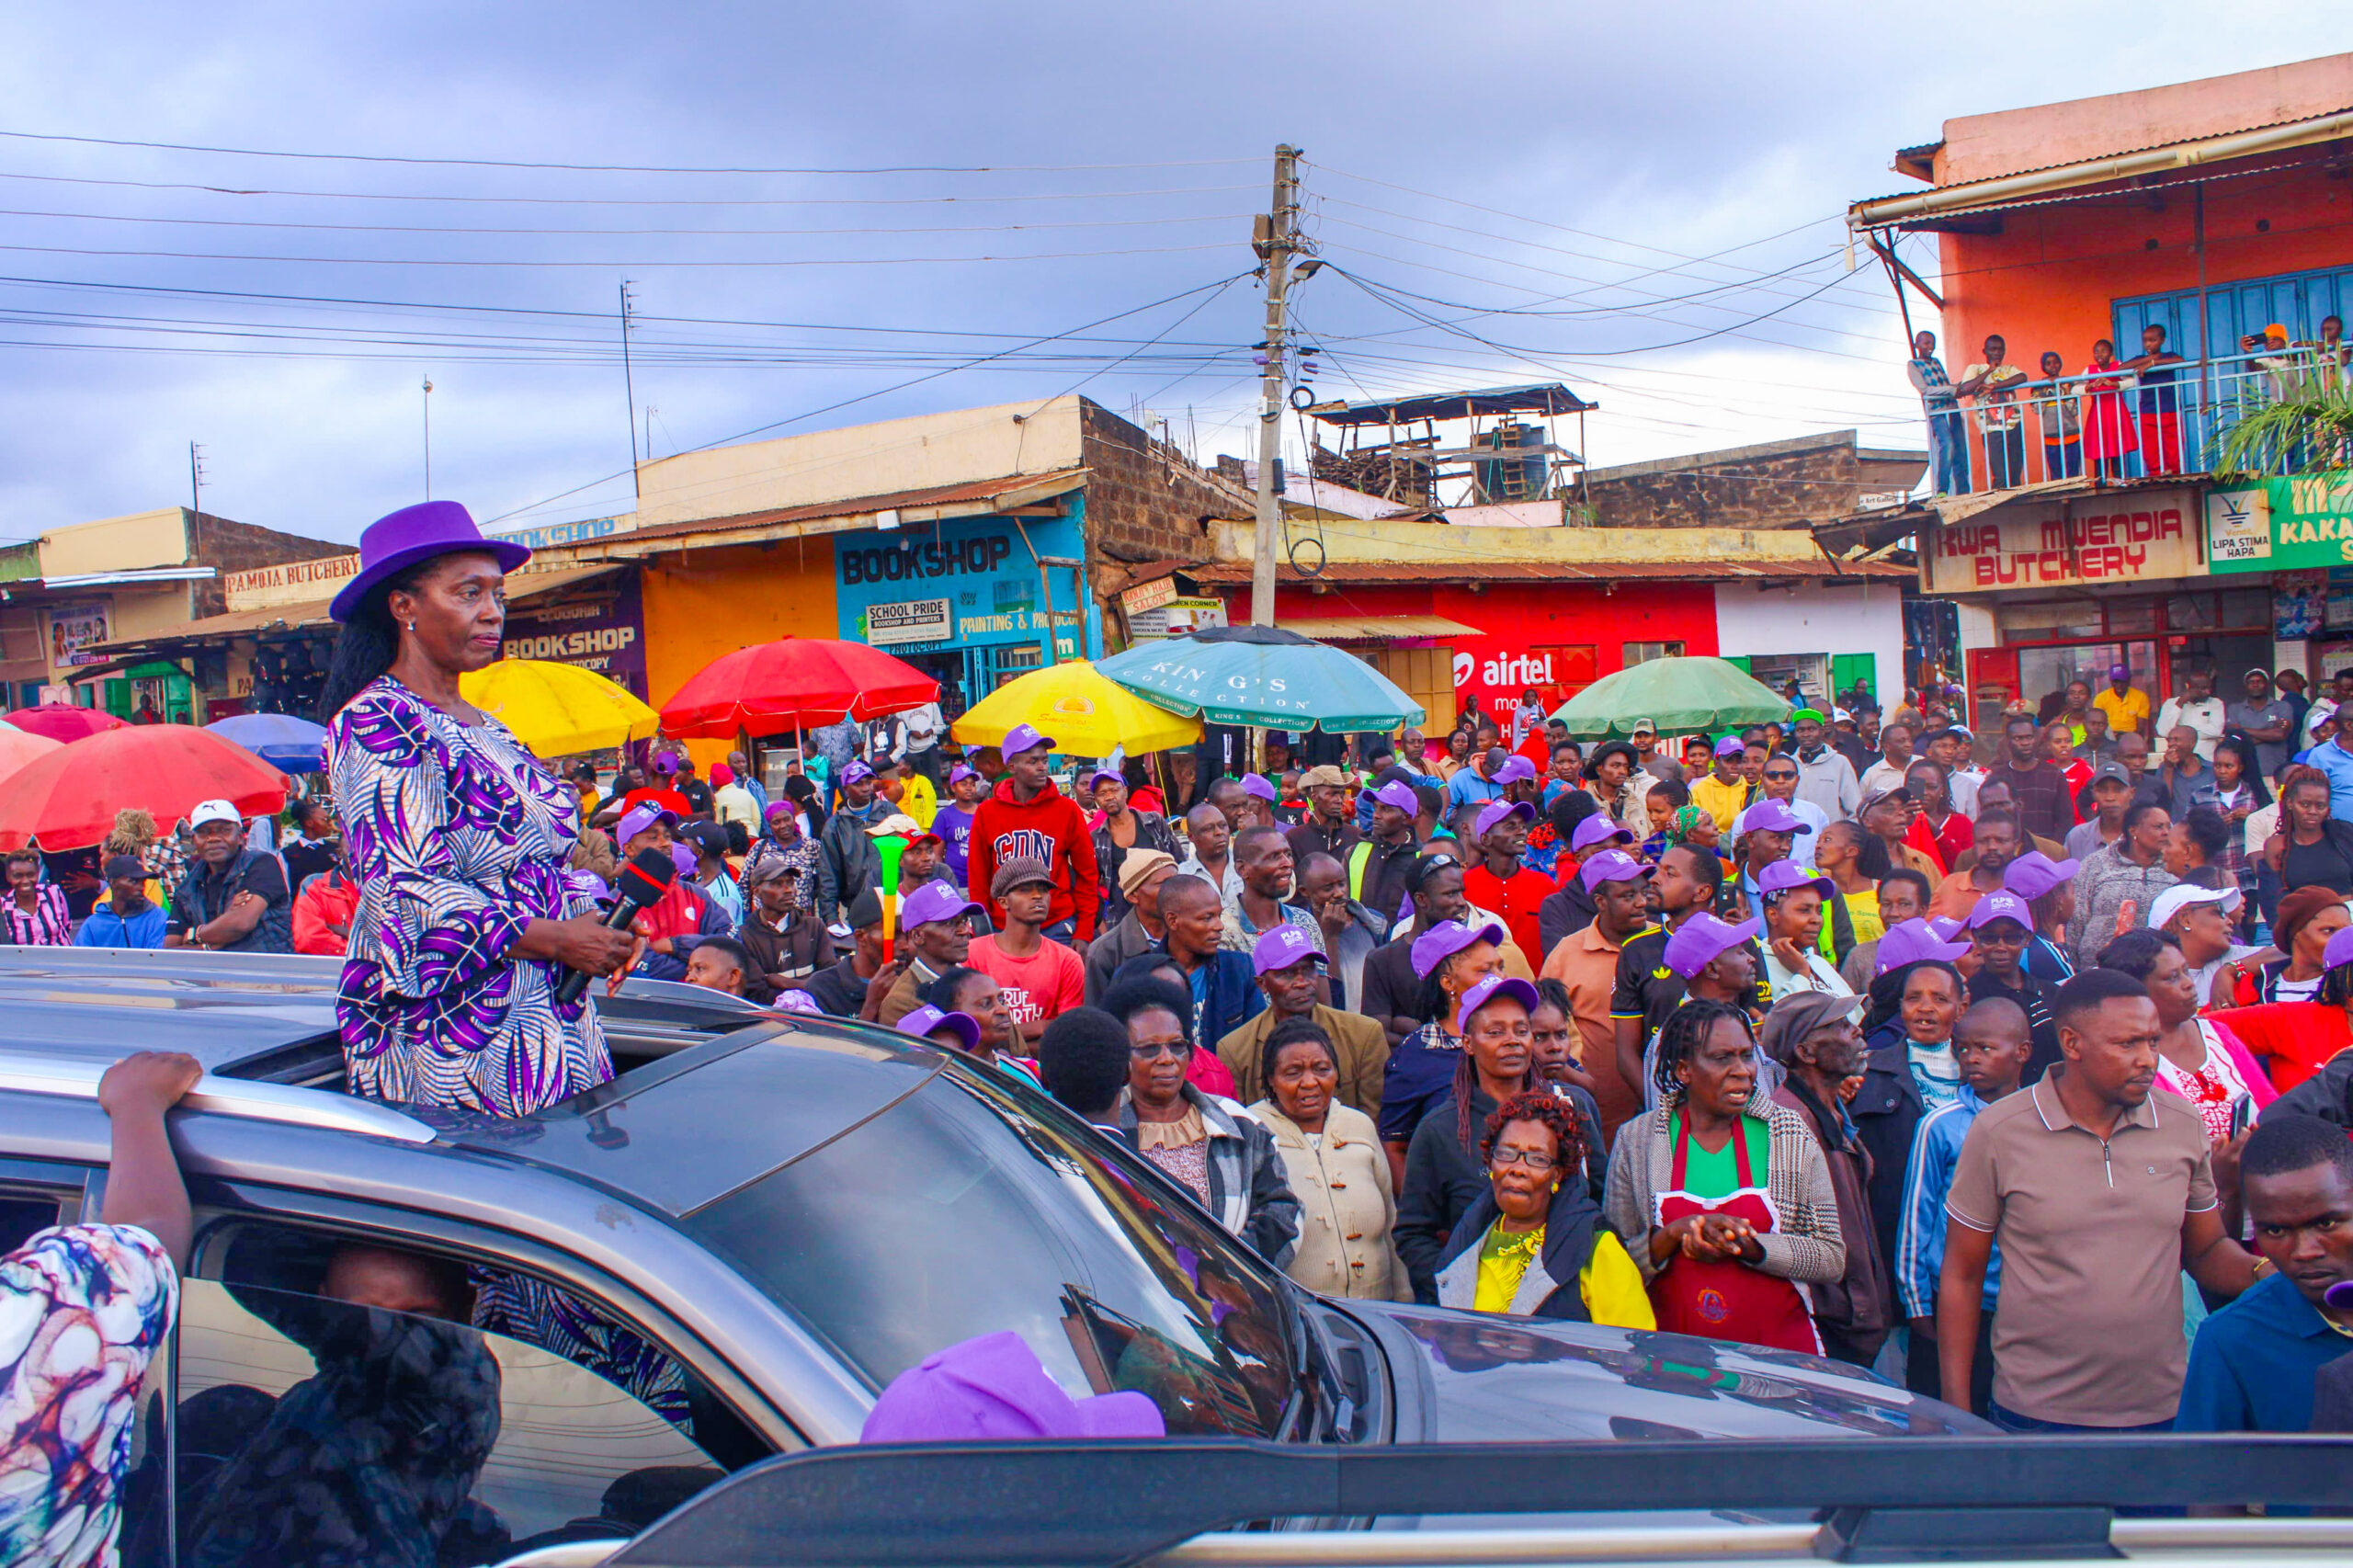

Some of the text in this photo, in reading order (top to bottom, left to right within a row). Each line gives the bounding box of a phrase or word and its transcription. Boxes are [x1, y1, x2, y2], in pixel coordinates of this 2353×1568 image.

[1937, 509, 2182, 558] KWA MWENDIA
[2212, 536, 2269, 550] LIPA STIMA
[843, 536, 1011, 585] BOOKSHOP
[2227, 547, 2256, 558] HAPA
[226, 555, 359, 593] PAMOJA BUTCHERY
[1975, 544, 2146, 586] BUTCHERY
[870, 601, 944, 619] SCHOOL PRIDE
[1132, 593, 1166, 612] SALON
[874, 615, 941, 628] BOOKSHOP AND PRINTERS
[504, 627, 635, 659] BOOKSHOP
[889, 641, 942, 654] PHOTOCOPY
[1483, 652, 1555, 686] airtel
[1150, 693, 1192, 713] COLLECTION
[1258, 716, 1306, 727] COLLECTION
